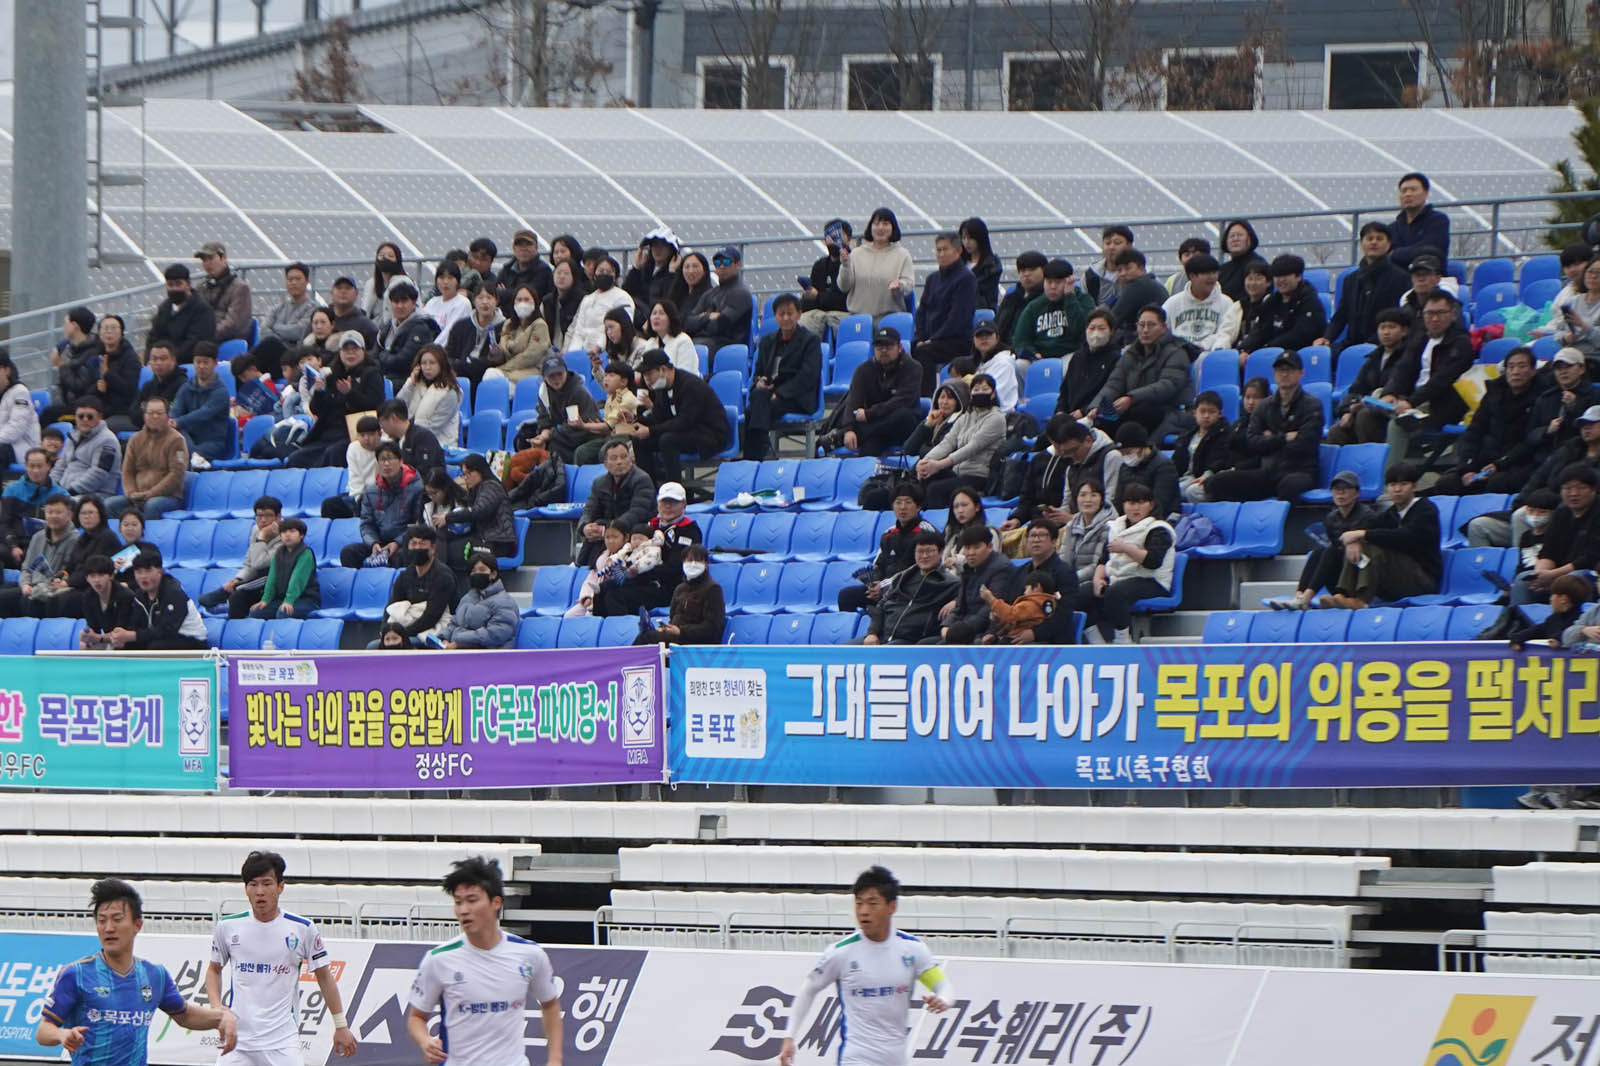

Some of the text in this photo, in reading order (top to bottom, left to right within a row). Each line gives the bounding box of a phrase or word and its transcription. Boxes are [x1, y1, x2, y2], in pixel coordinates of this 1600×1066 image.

[723, 680, 746, 697] 청년이
[748, 680, 763, 697] 찾는
[784, 663, 994, 741] 그대들이여
[1007, 663, 1145, 742] 나아가
[1154, 661, 1292, 743] 목포의
[1307, 660, 1453, 743] 위용을
[39, 696, 164, 746] 목포답게
[246, 690, 302, 747] 빛나는
[306, 691, 343, 747] 너의
[347, 690, 384, 748] 꿈을
[389, 688, 463, 748] 응원할게
[469, 684, 536, 744] FC목포
[692, 713, 736, 743] 큰 목포
[415, 752, 473, 779] 정상FC
[1076, 754, 1212, 783] 목포시축구협회
